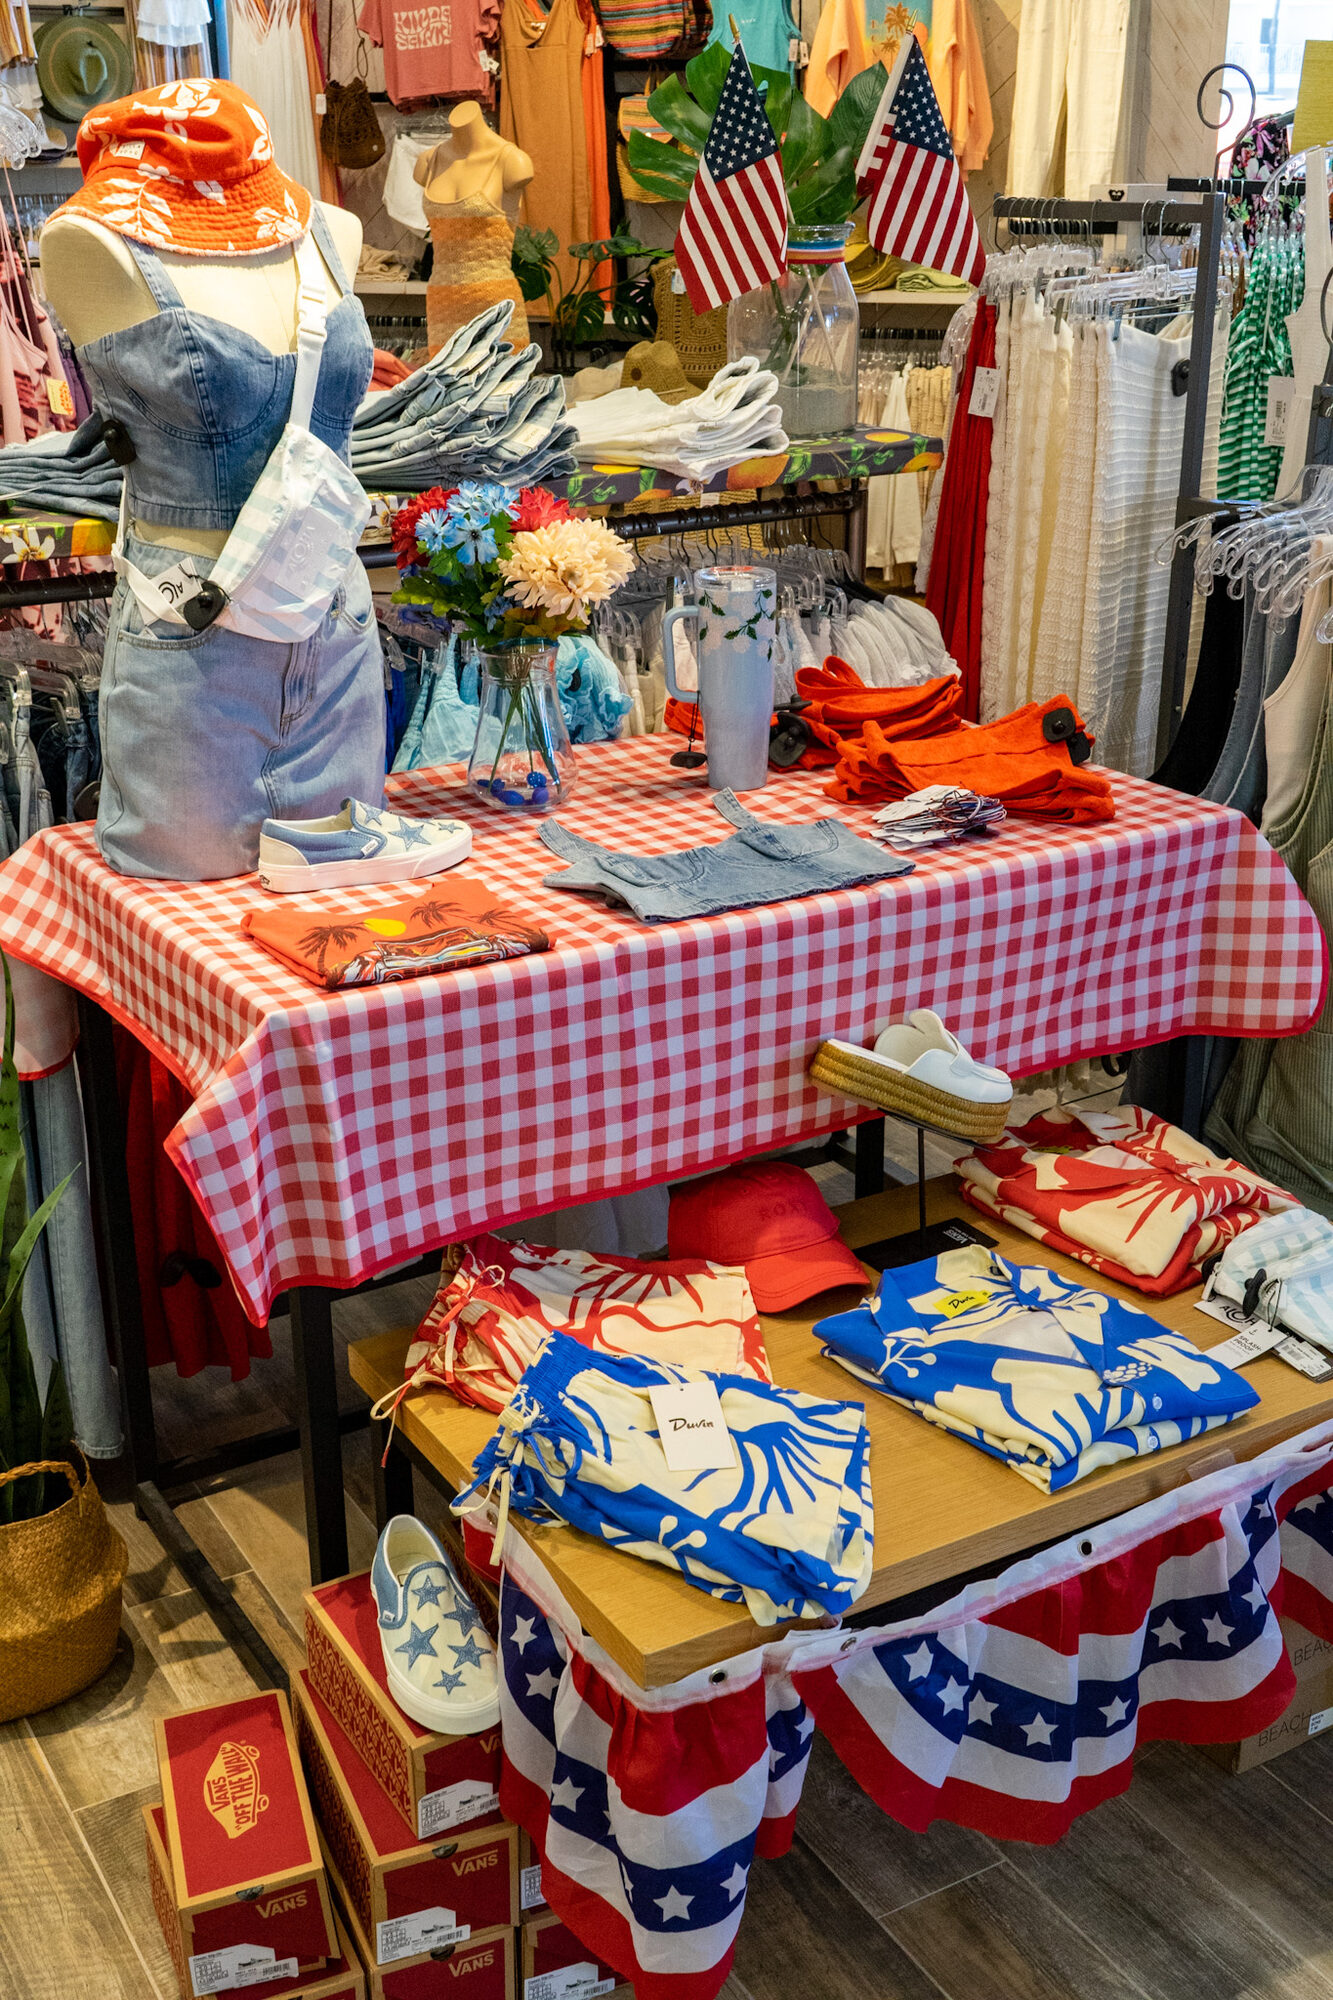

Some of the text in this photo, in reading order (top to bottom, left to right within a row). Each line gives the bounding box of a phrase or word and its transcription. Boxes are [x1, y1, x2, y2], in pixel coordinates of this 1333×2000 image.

[1219, 1305, 1258, 1326] ALOH
[668, 1417, 714, 1431] Duvin
[207, 1776, 231, 1813] VANS
[228, 1774, 253, 1803] THE
[451, 1849, 498, 1877] VANS
[255, 1890, 308, 1918] VANS
[448, 1949, 495, 1977] VANS
